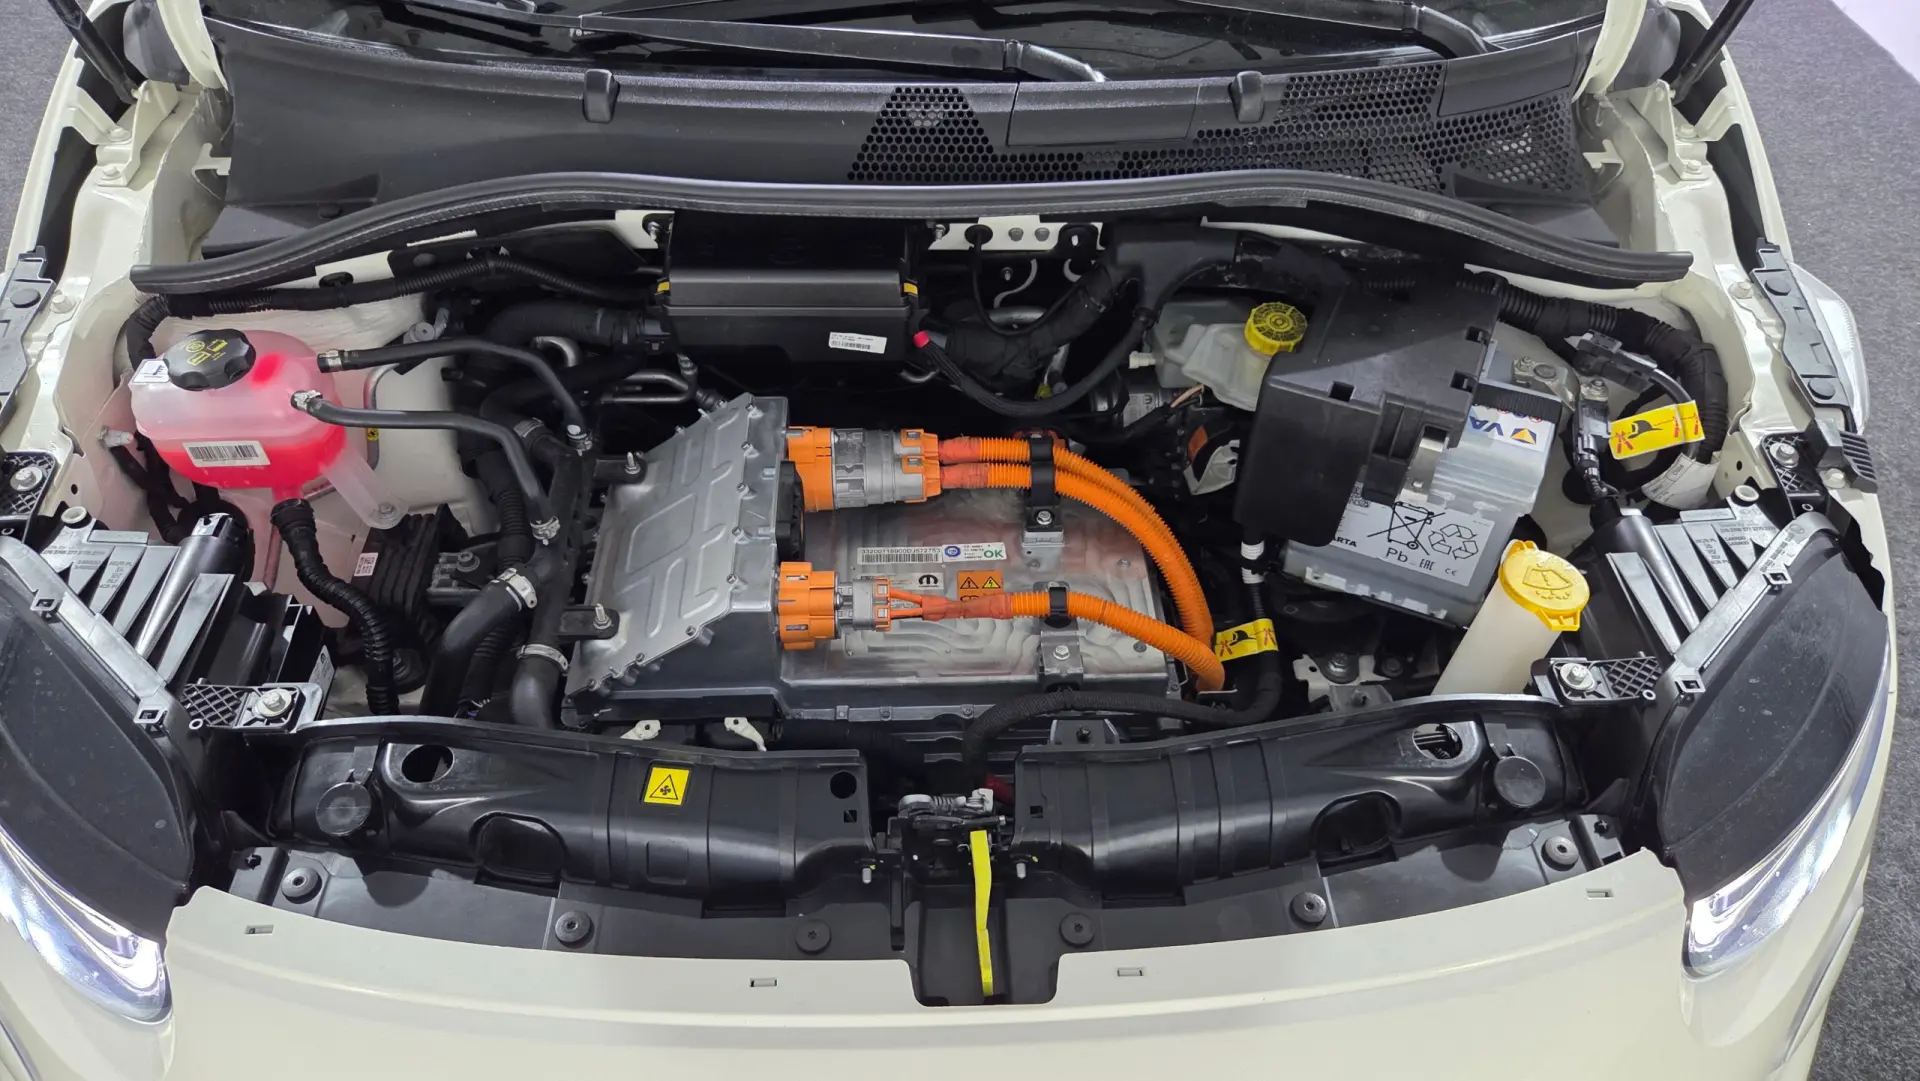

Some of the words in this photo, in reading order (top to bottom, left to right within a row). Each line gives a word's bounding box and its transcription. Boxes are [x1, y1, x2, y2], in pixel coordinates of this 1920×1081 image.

[1333, 536, 1357, 548] RTA
[983, 549, 1004, 559] OK
[1385, 547, 1409, 563] Pb
